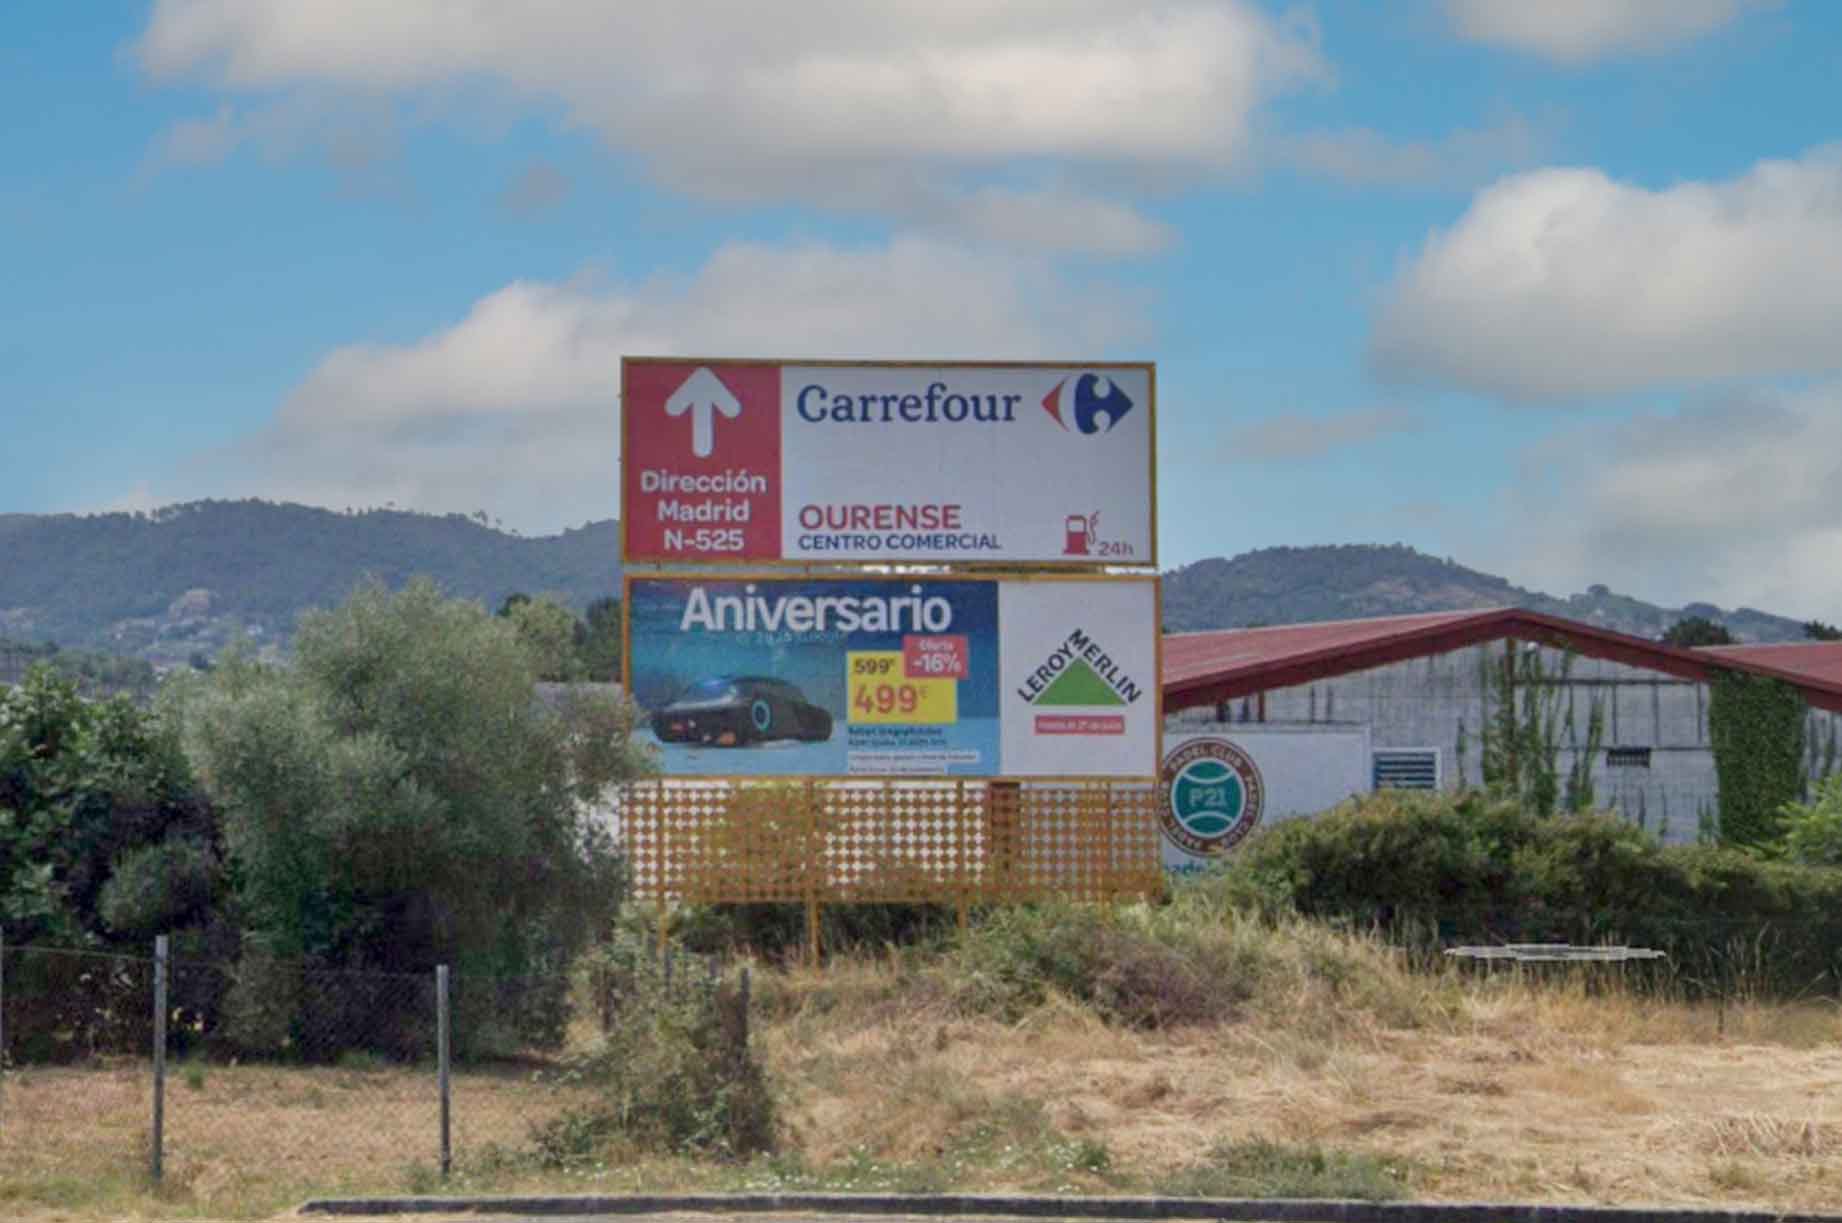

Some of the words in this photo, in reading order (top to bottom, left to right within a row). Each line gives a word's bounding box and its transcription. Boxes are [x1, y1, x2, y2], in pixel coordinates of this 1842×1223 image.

[796, 382, 1022, 423] Carrefour
[641, 469, 767, 493] Dirección
[657, 498, 750, 521] Madrid
[799, 504, 962, 530] OURENSE
[663, 529, 744, 551] N-525
[798, 533, 882, 551] CENTRO
[885, 533, 1001, 551] COMERCIAL
[1098, 541, 1134, 556] 24h
[680, 584, 952, 632] Aniversario
[1017, 641, 1074, 703] LEROY
[1069, 628, 1143, 704] MERLIN
